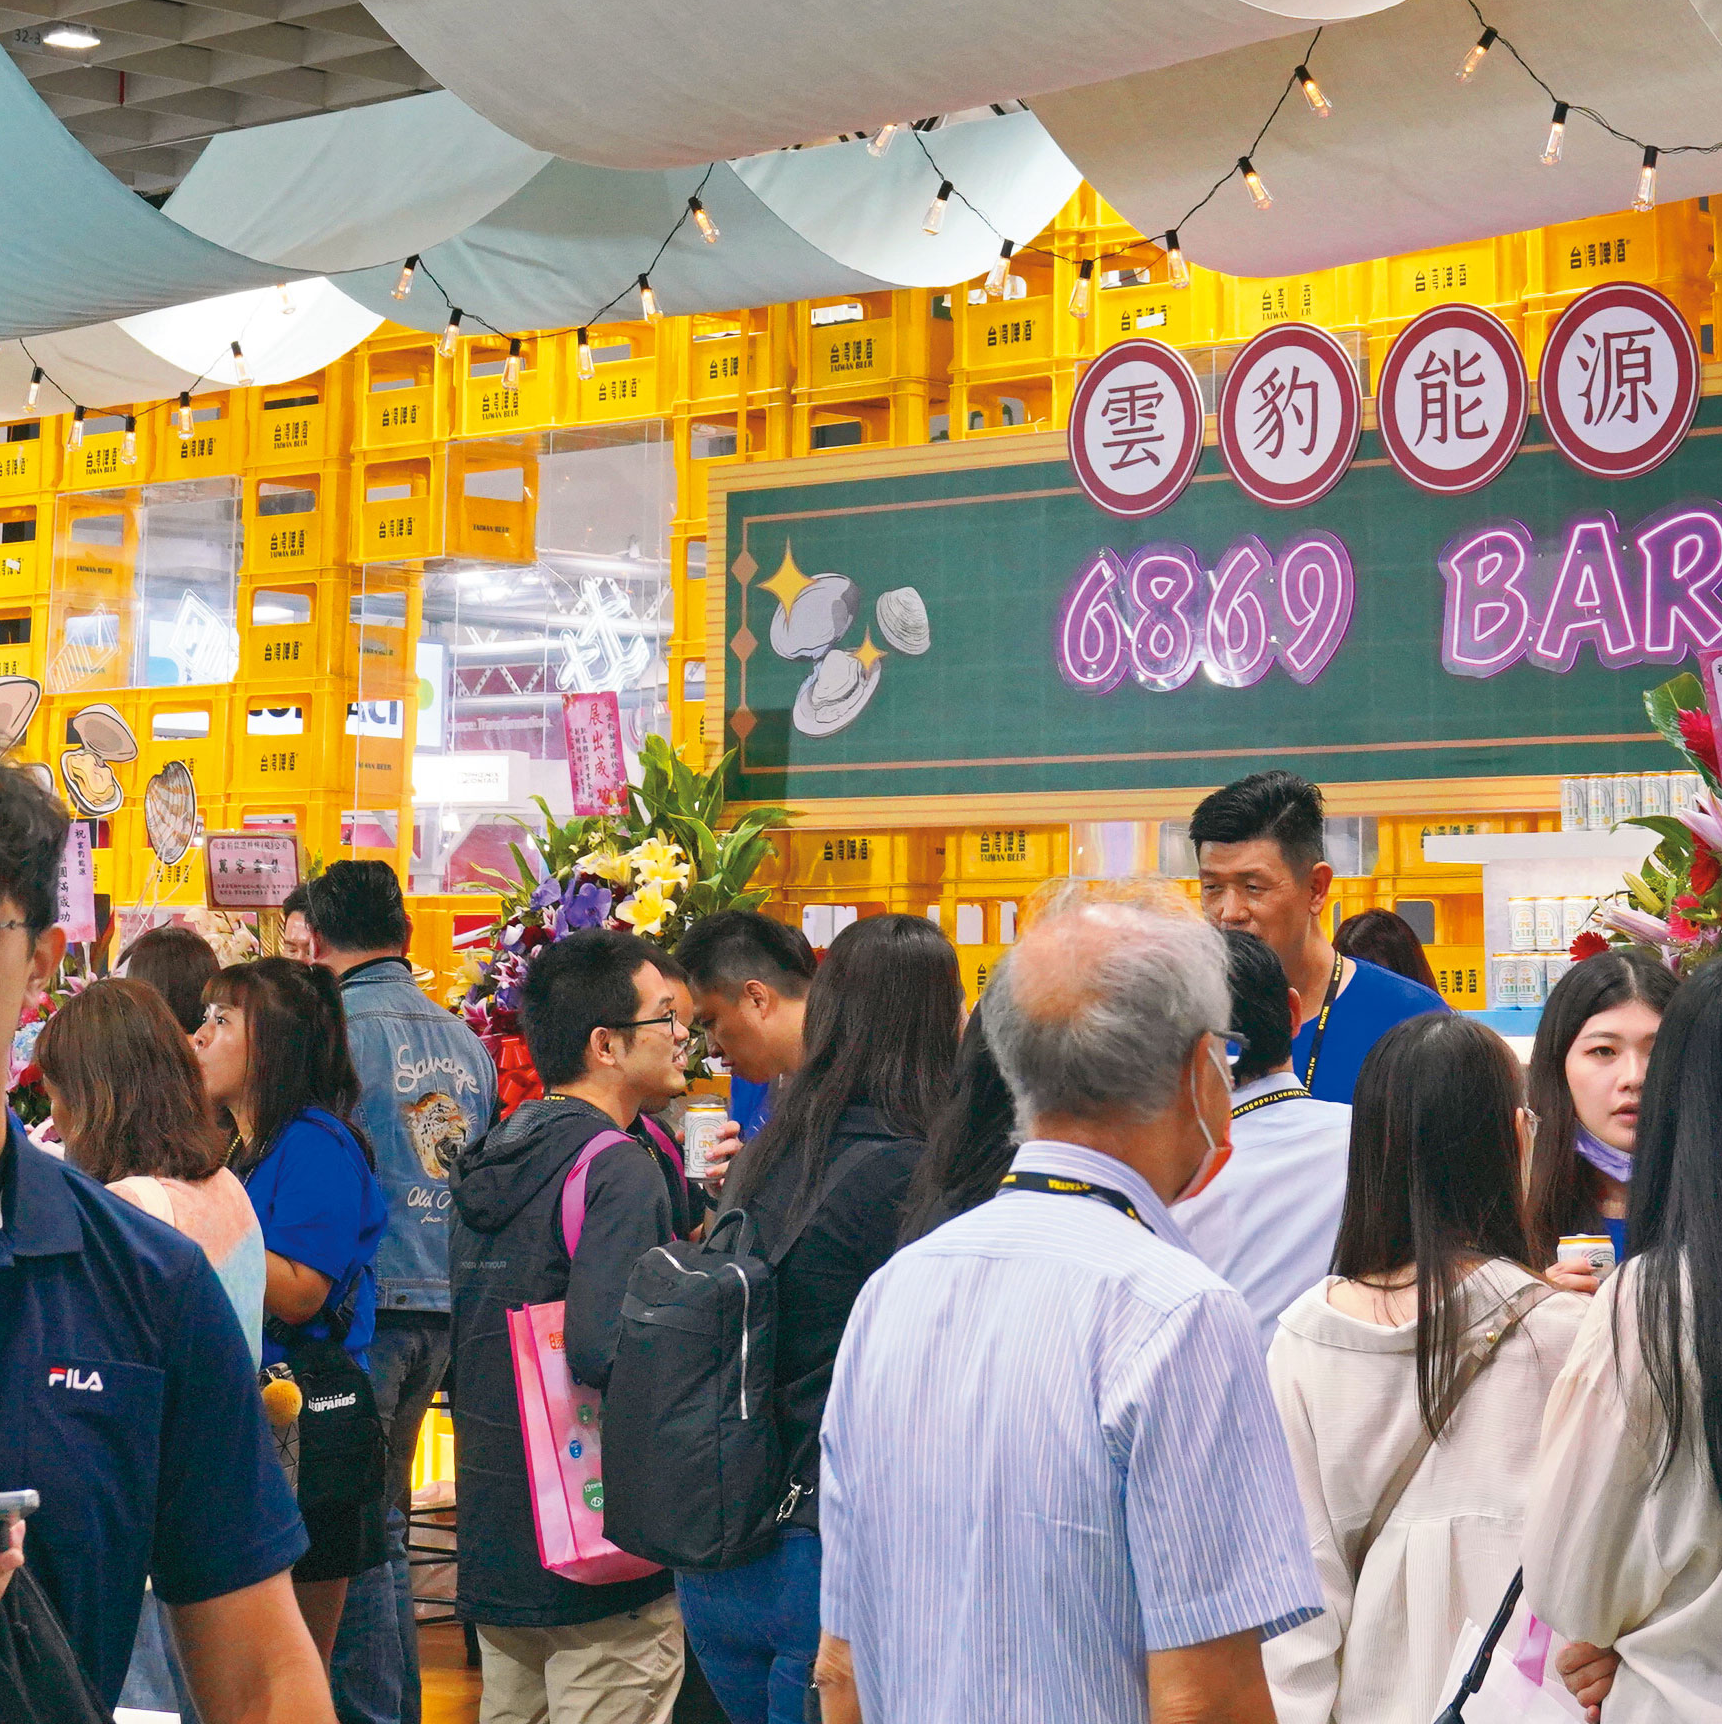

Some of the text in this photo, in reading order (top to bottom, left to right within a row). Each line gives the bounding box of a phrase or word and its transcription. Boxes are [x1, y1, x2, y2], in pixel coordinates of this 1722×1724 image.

[1101, 325, 1657, 471] 雲豹能源
[1062, 536, 1347, 686] 6869
[395, 1044, 480, 1094] Savage
[407, 1186, 433, 1208] Old
[48, 1367, 104, 1392] FILA
[308, 1392, 356, 1412] LEOPARDS
